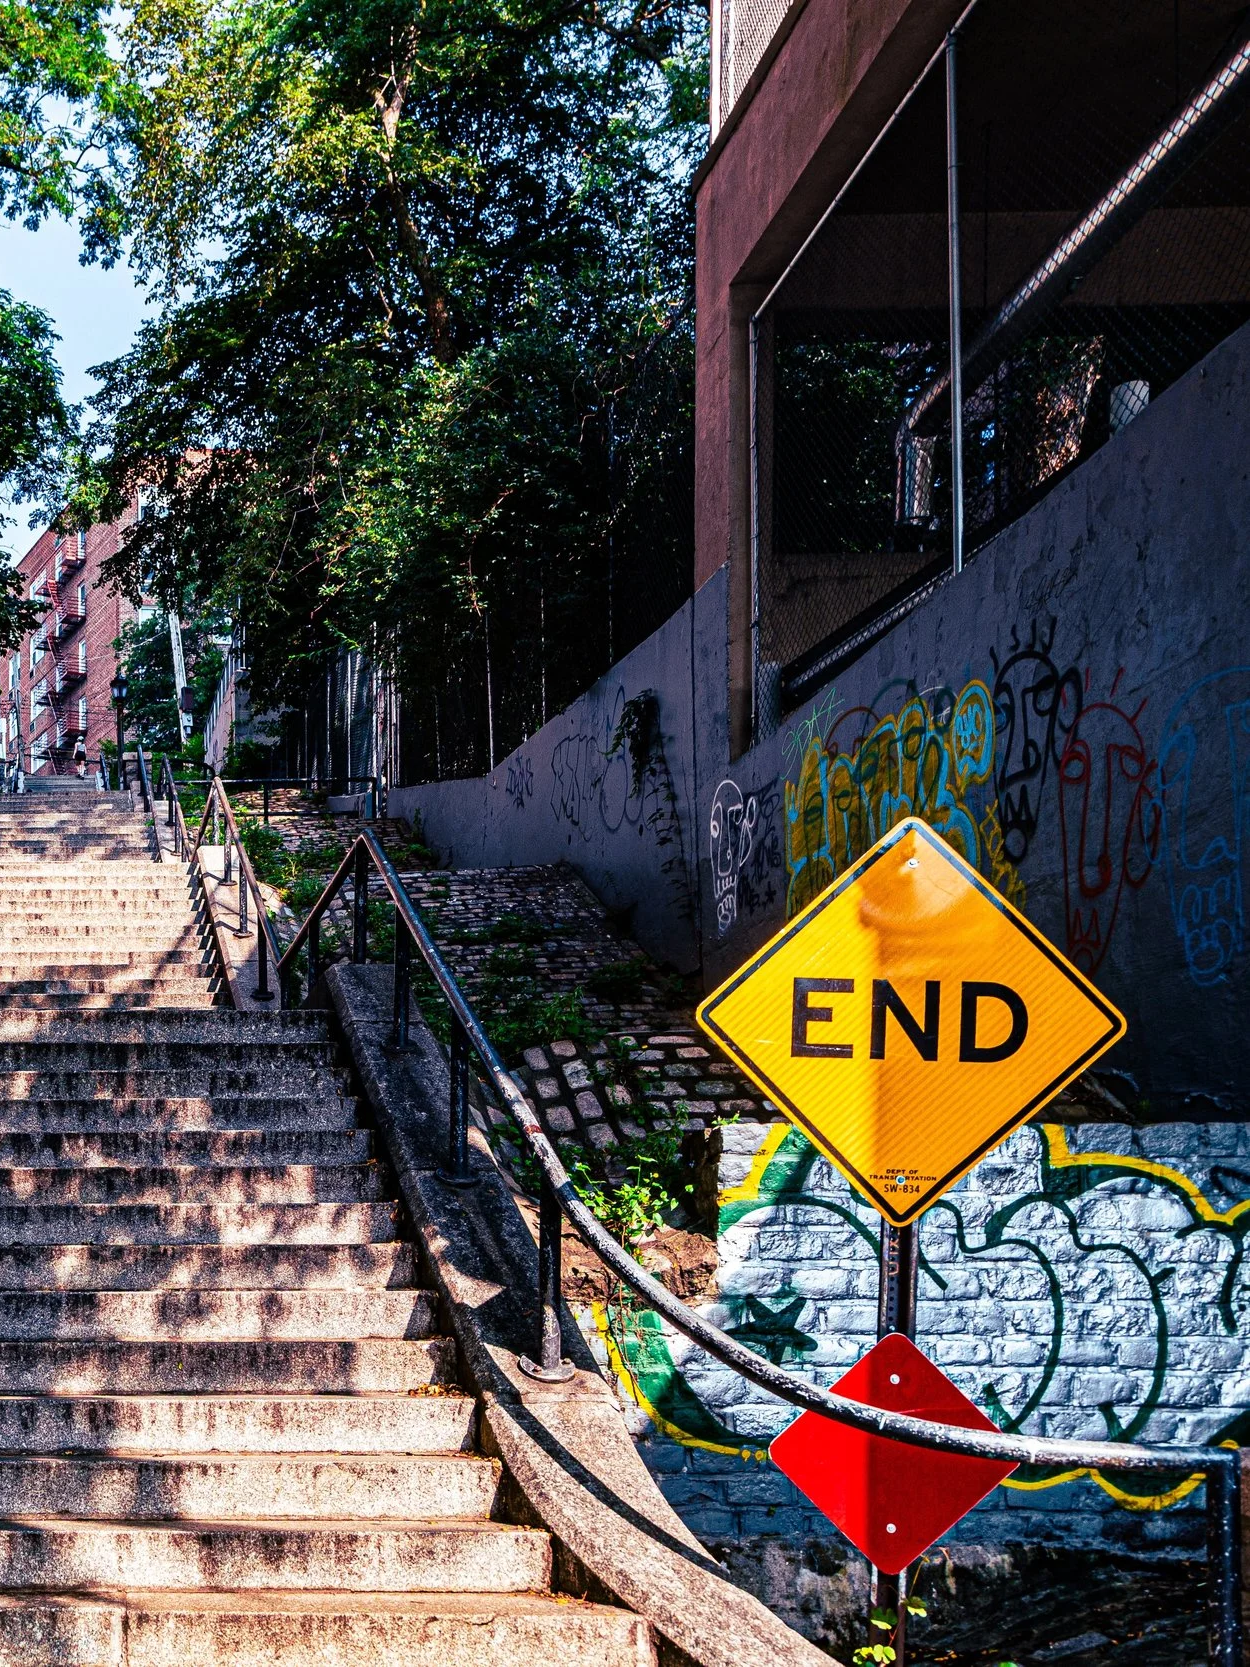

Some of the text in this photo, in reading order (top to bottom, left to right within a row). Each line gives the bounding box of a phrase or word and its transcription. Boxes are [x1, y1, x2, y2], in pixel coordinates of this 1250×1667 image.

[790, 976, 1030, 1063] END
[869, 1174, 937, 1182] TRANSRTATION
[883, 1183, 920, 1194] SW-834
